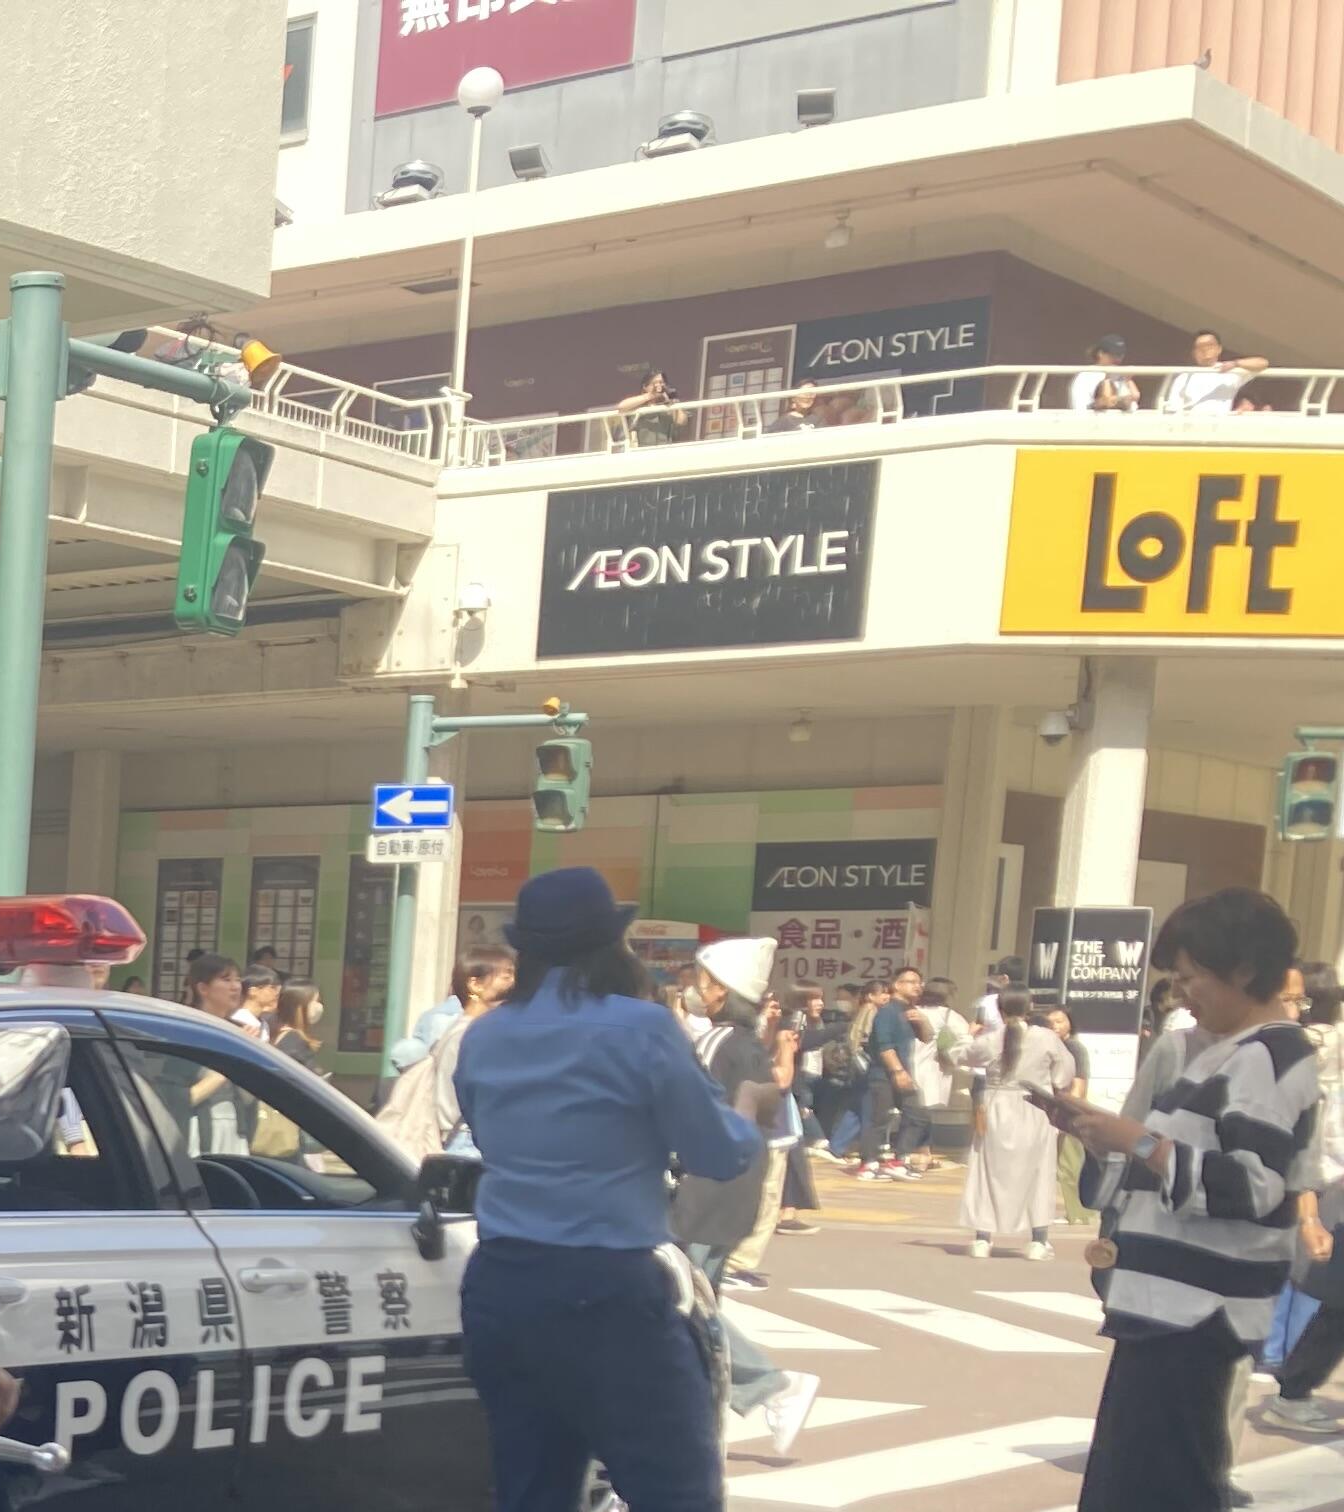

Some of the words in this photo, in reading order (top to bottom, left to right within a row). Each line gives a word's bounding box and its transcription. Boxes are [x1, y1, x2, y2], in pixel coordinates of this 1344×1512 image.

[890, 323, 976, 357] STYLE
[699, 531, 850, 584] STYLE
[843, 864, 927, 887] STYLE
[1073, 940, 1104, 954] THE
[1072, 954, 1106, 967] SUIT
[1071, 967, 1142, 981] COMPANY
[54, 1355, 386, 1459] POLICE
